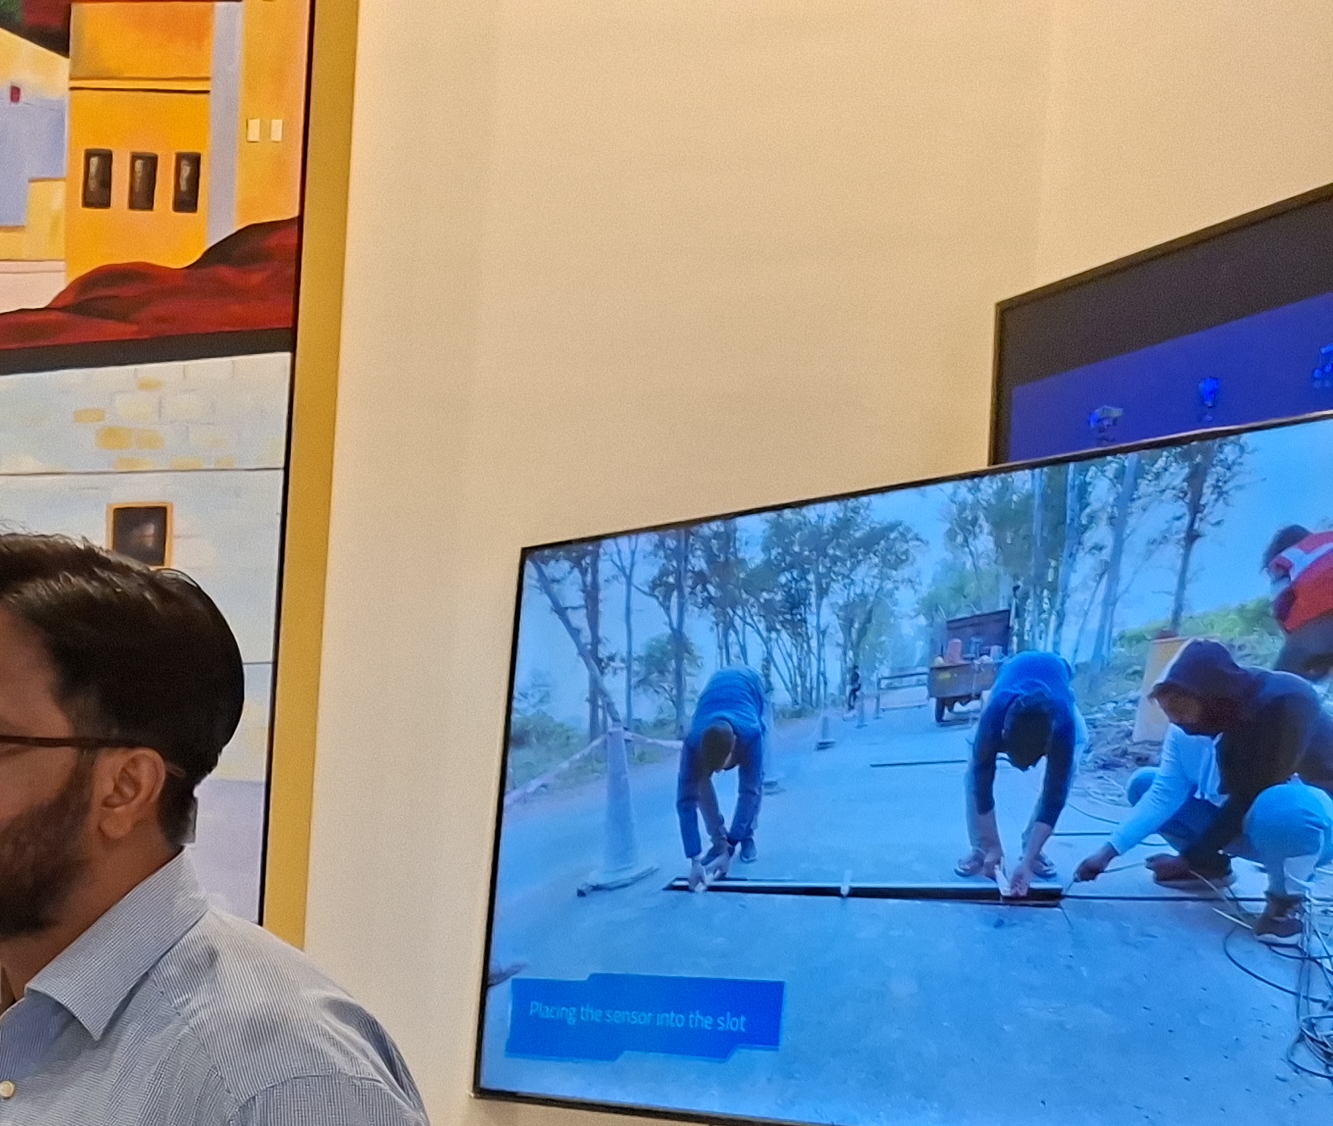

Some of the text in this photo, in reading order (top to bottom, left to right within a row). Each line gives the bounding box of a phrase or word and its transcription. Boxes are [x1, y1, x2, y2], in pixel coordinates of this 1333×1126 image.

[529, 1000, 746, 1032] Placing the sensor into the slot
